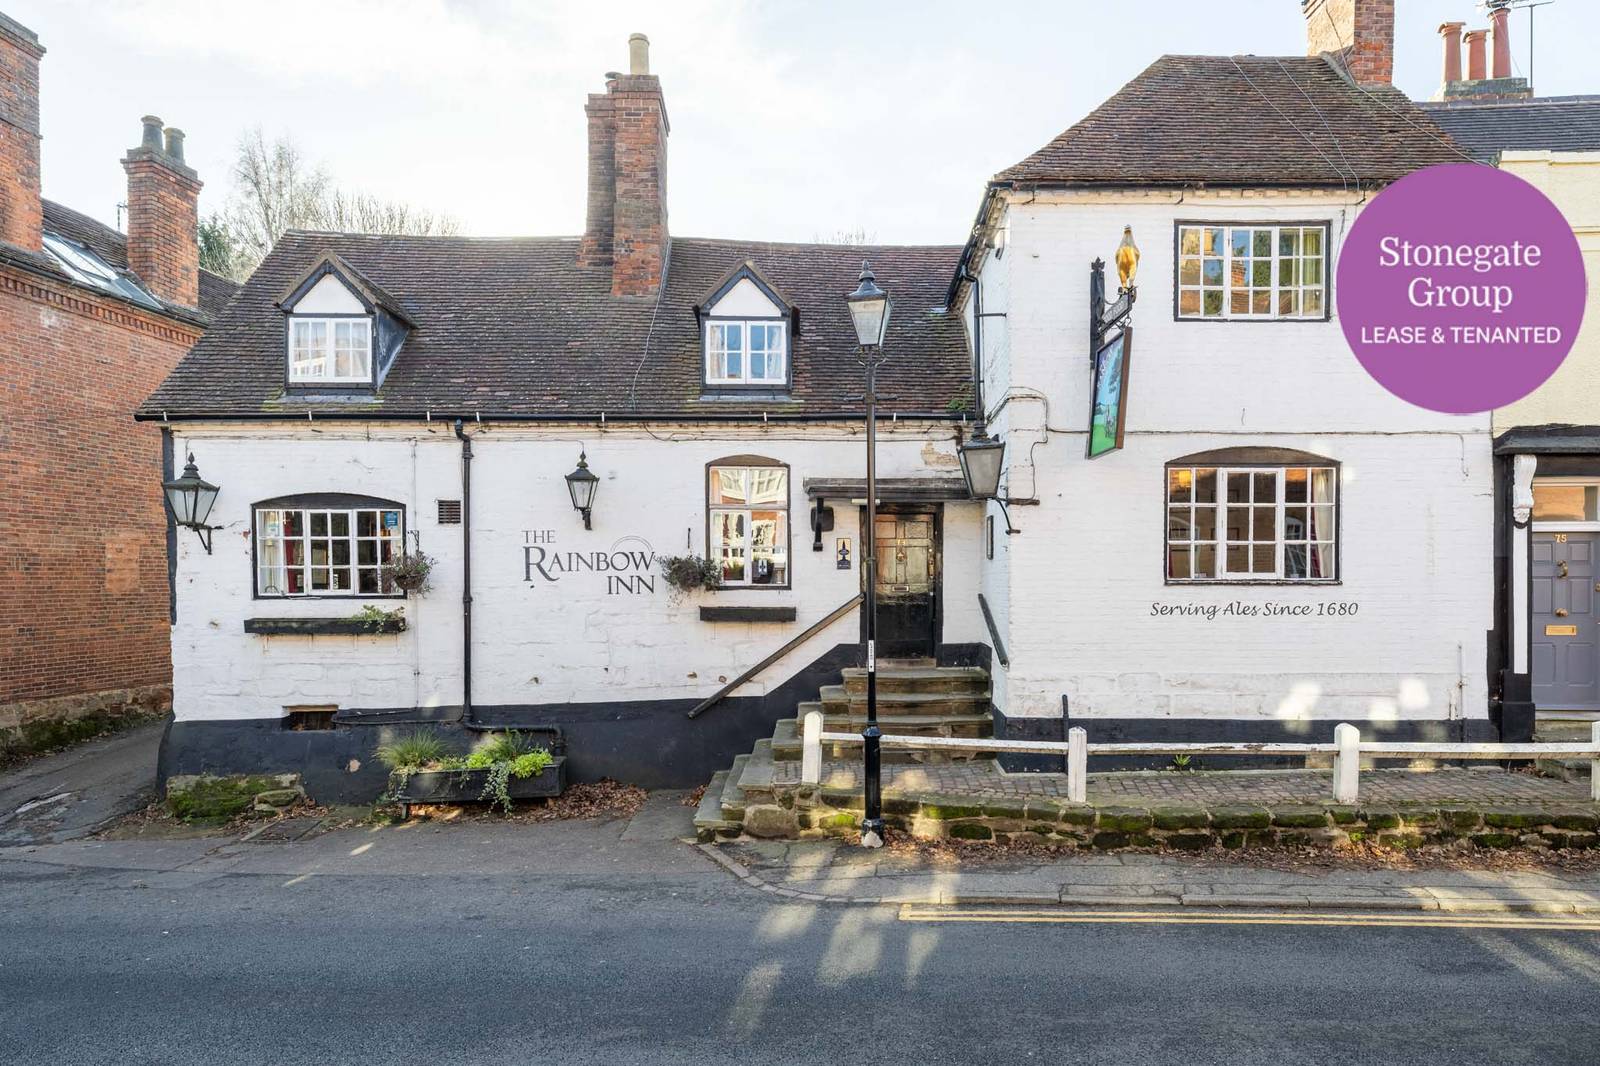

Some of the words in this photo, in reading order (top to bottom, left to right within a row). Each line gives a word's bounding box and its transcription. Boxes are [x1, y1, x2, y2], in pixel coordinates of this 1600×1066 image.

[521, 529, 557, 544] THE
[1555, 534, 1567, 542] 75
[522, 546, 655, 582] RAINBOW
[607, 575, 655, 595] INN
[1150, 602, 1220, 620] Serving
[1222, 601, 1261, 616] Ales
[1262, 602, 1314, 616] Since
[1317, 602, 1359, 616] 1680
